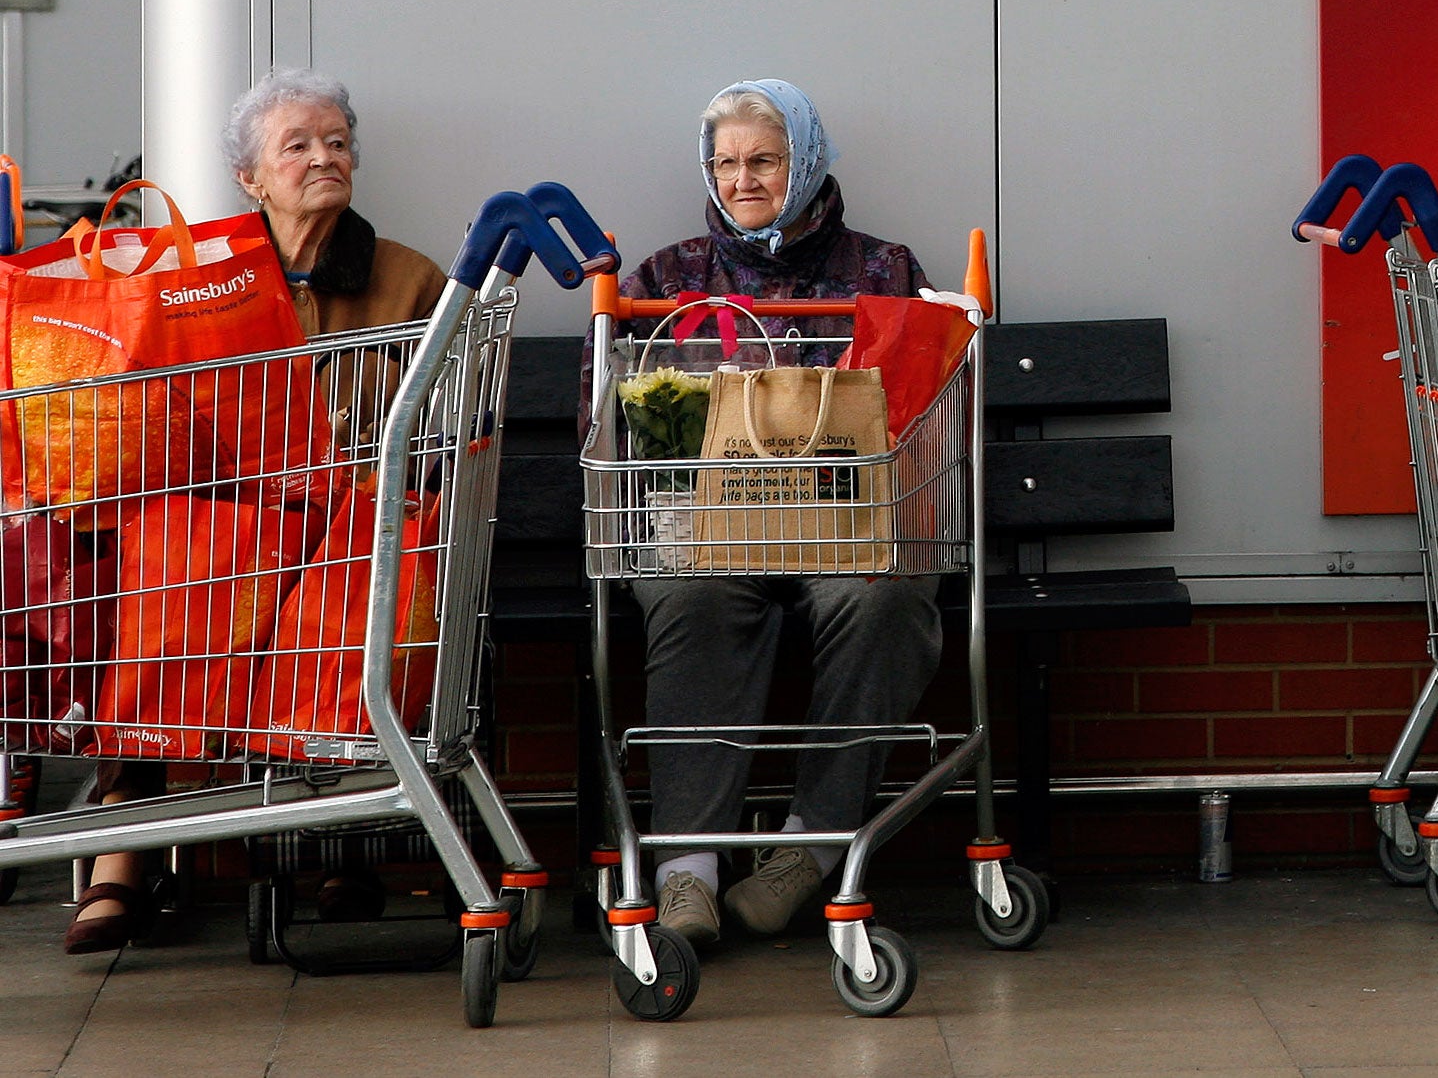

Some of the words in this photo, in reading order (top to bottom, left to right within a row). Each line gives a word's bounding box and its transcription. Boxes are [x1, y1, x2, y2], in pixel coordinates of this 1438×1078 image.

[160, 269, 255, 307] Sainsbury's
[199, 307, 213, 316] life
[33, 315, 47, 323] this
[48, 318, 62, 327] bag
[83, 325, 99, 336] cost
[739, 438, 752, 448] no
[760, 436, 776, 447] ust
[778, 437, 795, 448] our
[798, 433, 856, 447] Sasbury's
